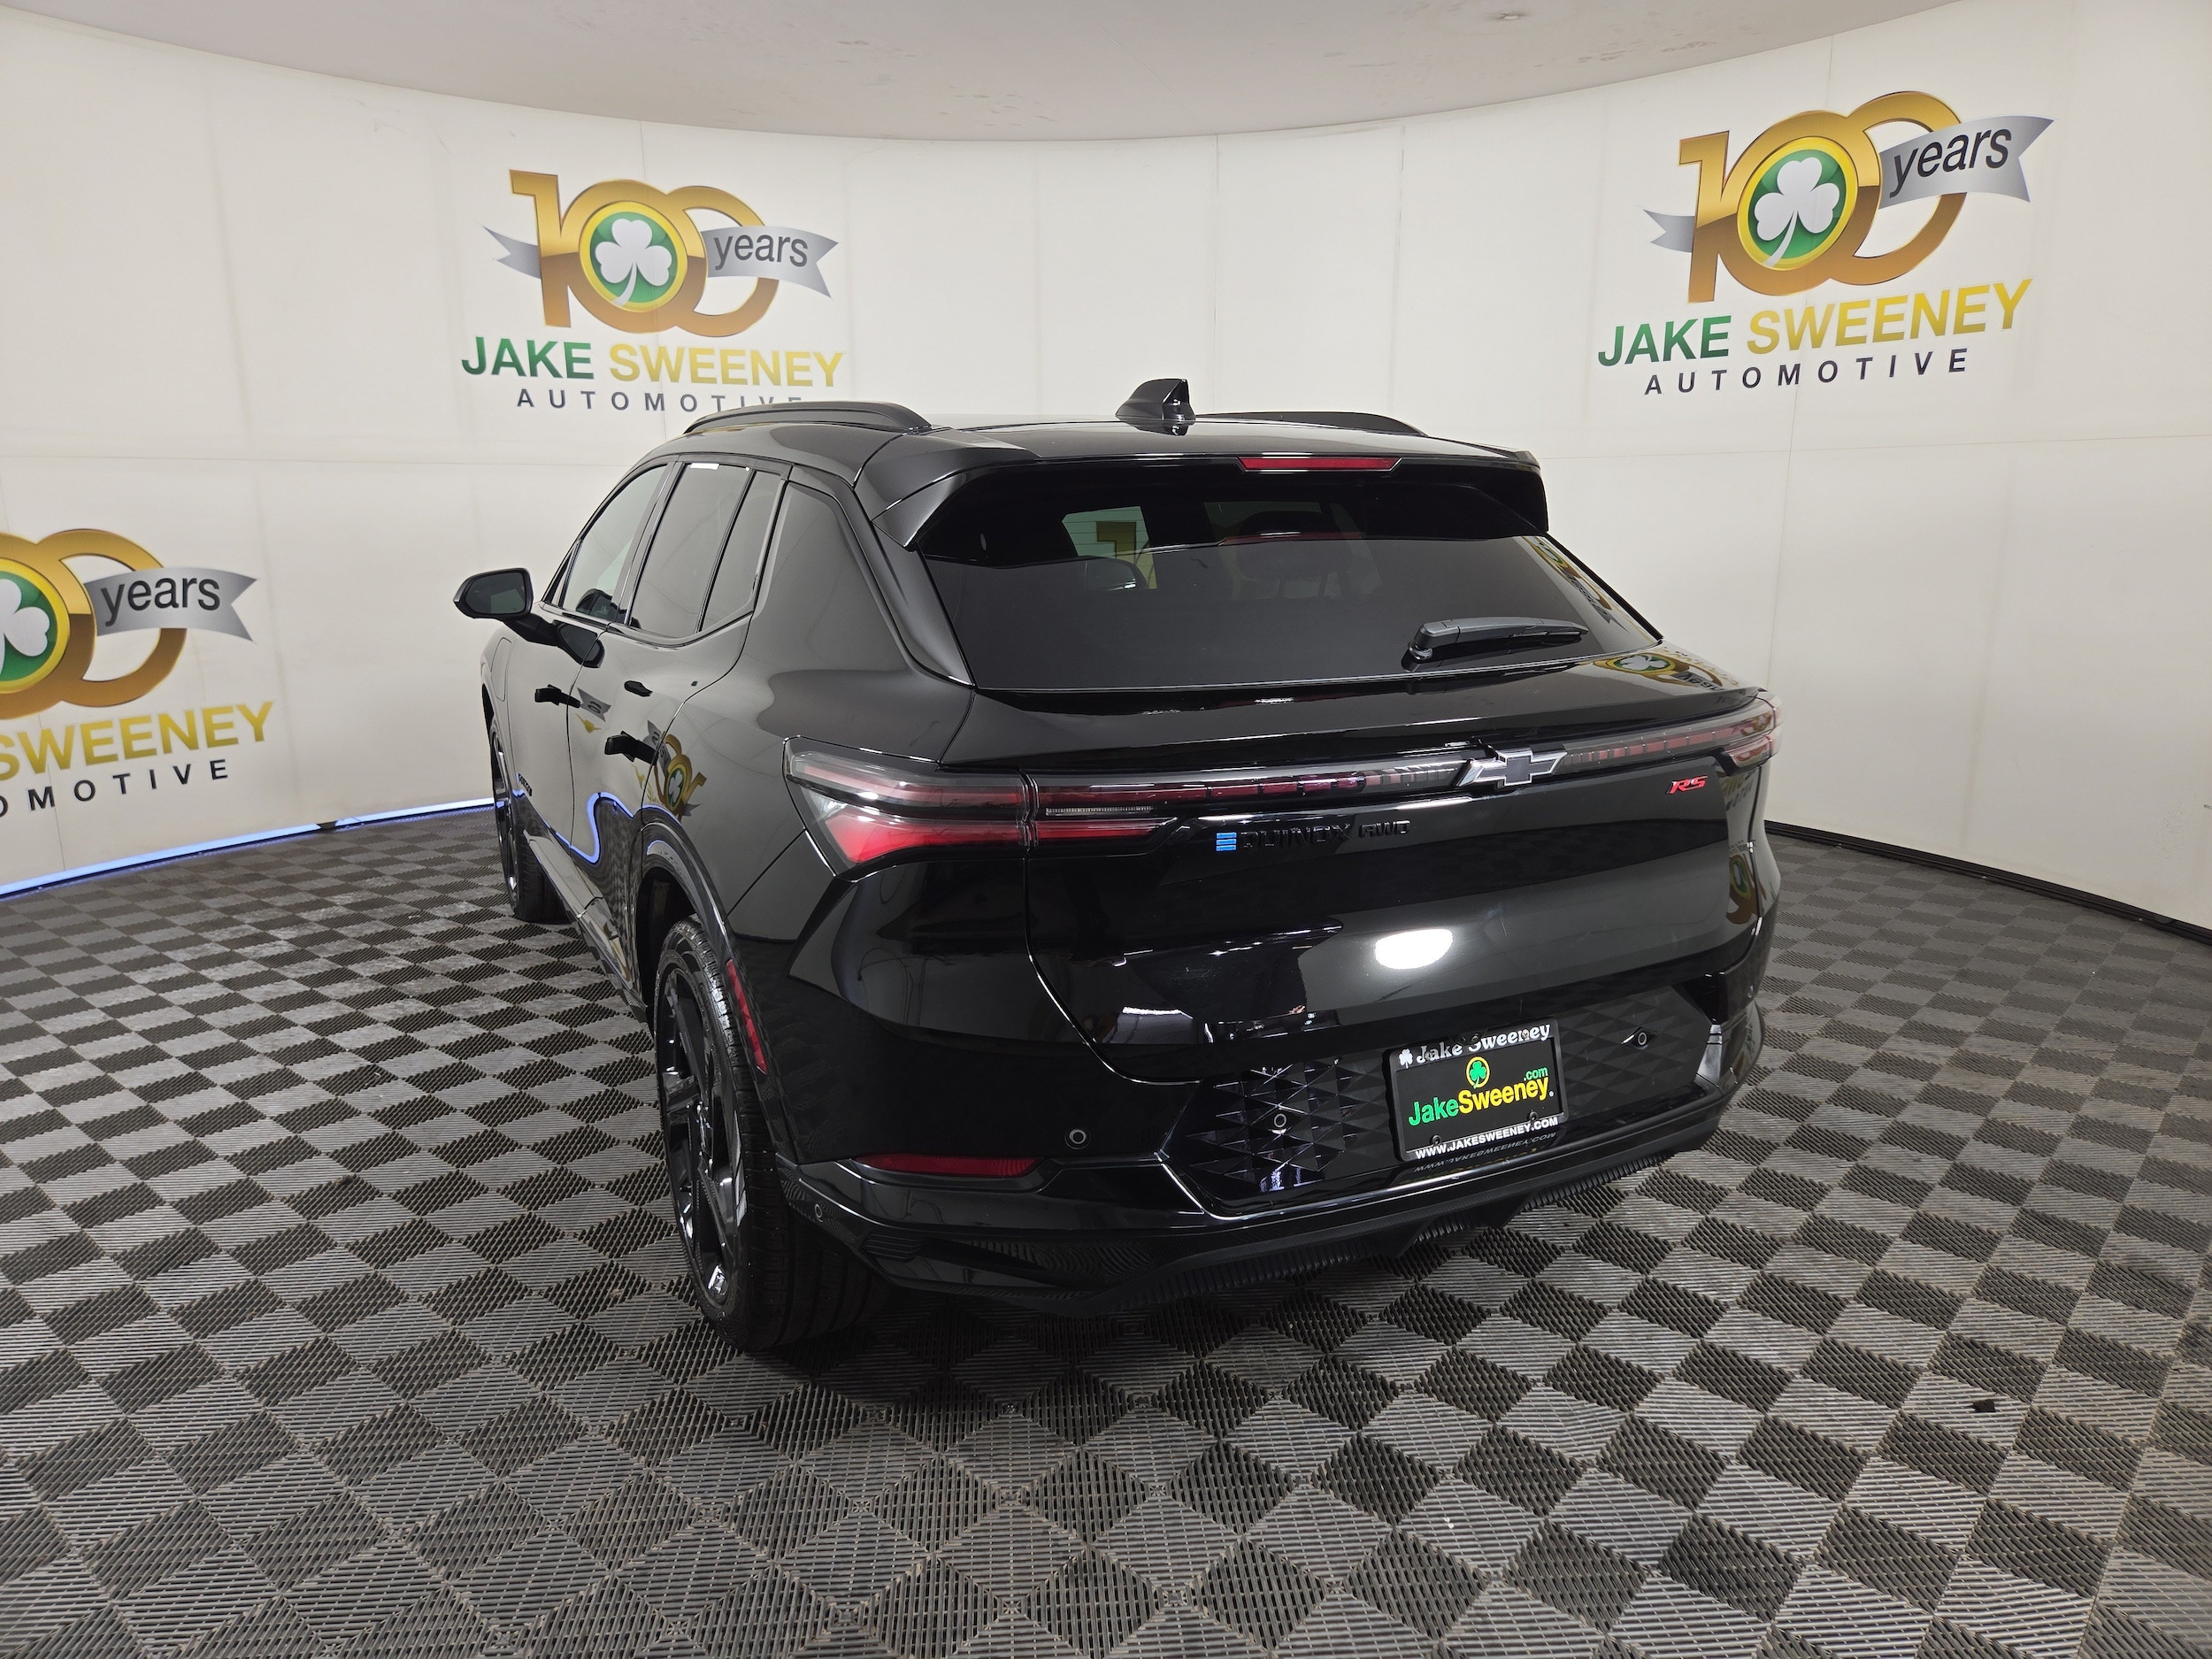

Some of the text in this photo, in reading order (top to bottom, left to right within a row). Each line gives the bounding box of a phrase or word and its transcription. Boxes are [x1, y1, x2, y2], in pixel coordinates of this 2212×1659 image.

[1889, 127, 2012, 198] years
[1678, 90, 1966, 303] 100
[509, 169, 780, 337] 100
[713, 234, 809, 271] years
[1598, 278, 2034, 367] JAKE SWEENEY
[461, 336, 845, 388] JAKE SWEENEY
[1644, 348, 1968, 396] AUTOMOTIVE
[100, 577, 221, 627] years
[1665, 775, 1709, 795] RS
[1416, 1041, 1463, 1064] Jake
[1415, 1116, 1559, 1160] WWW.JAKESWEENEY.COM
